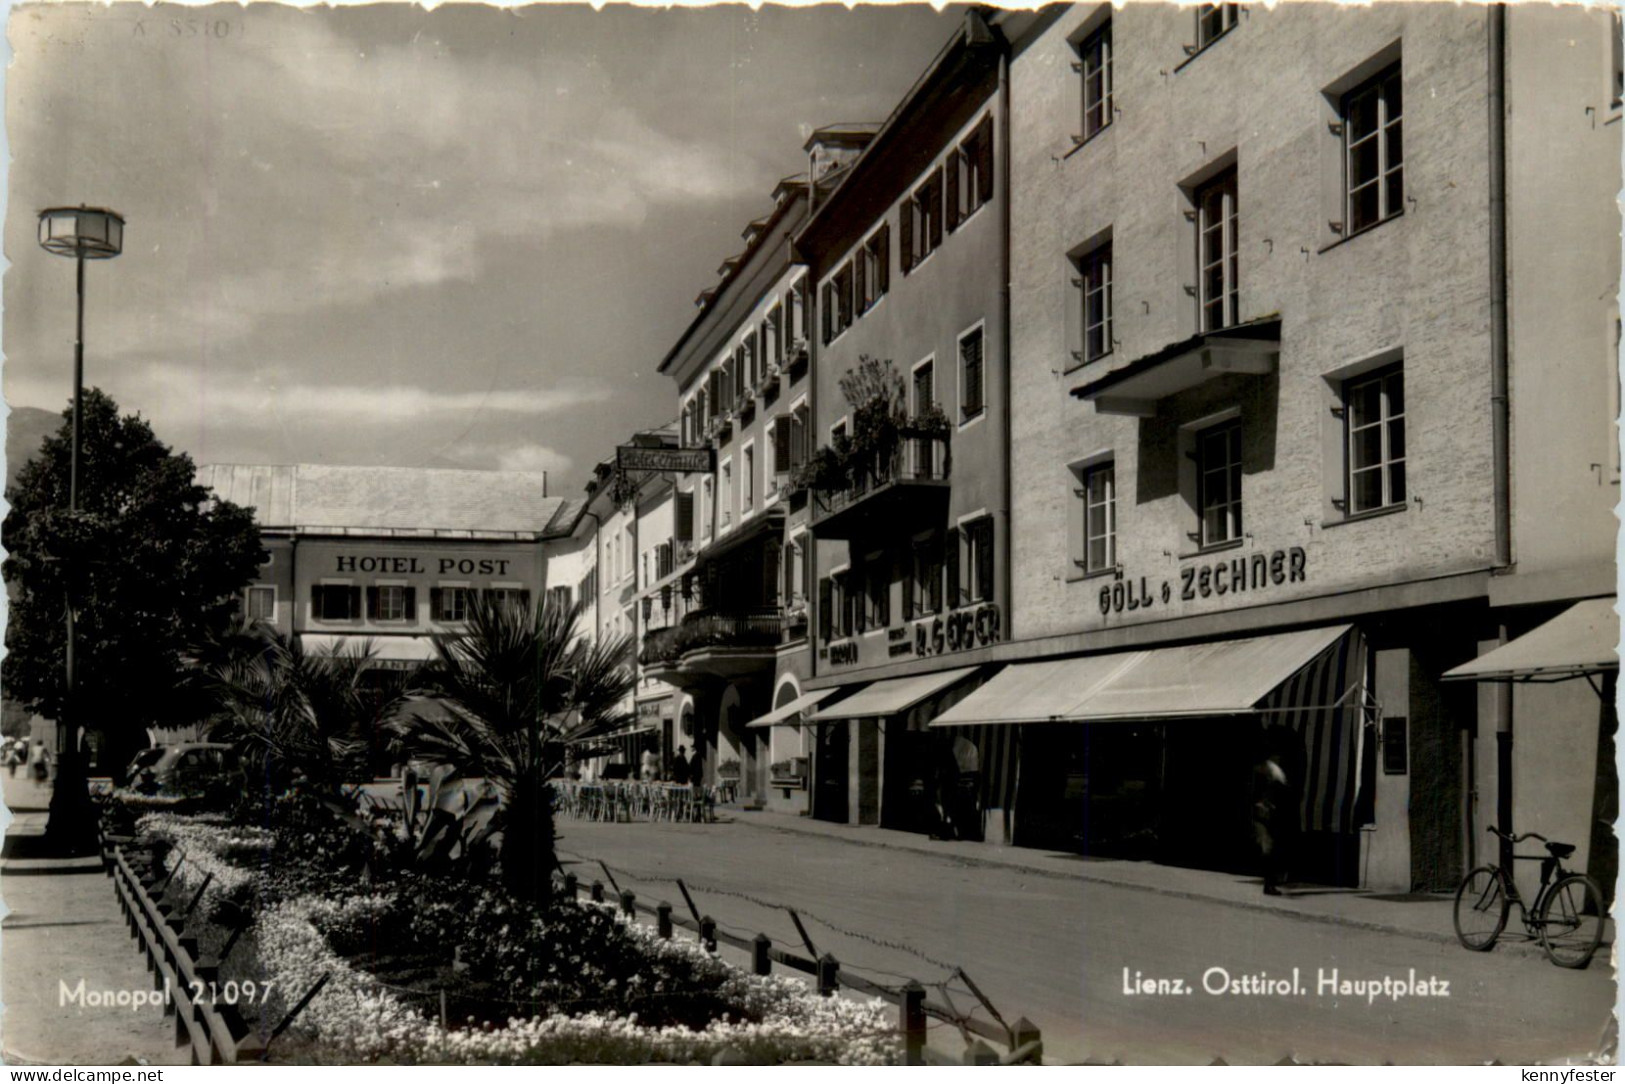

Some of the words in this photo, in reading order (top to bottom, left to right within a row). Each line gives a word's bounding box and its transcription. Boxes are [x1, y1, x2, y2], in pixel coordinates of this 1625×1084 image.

[336, 555, 425, 574] HOTEL
[438, 558, 511, 576] POST
[1099, 571, 1153, 615] GÖLL
[1180, 546, 1306, 601] ZECHNER
